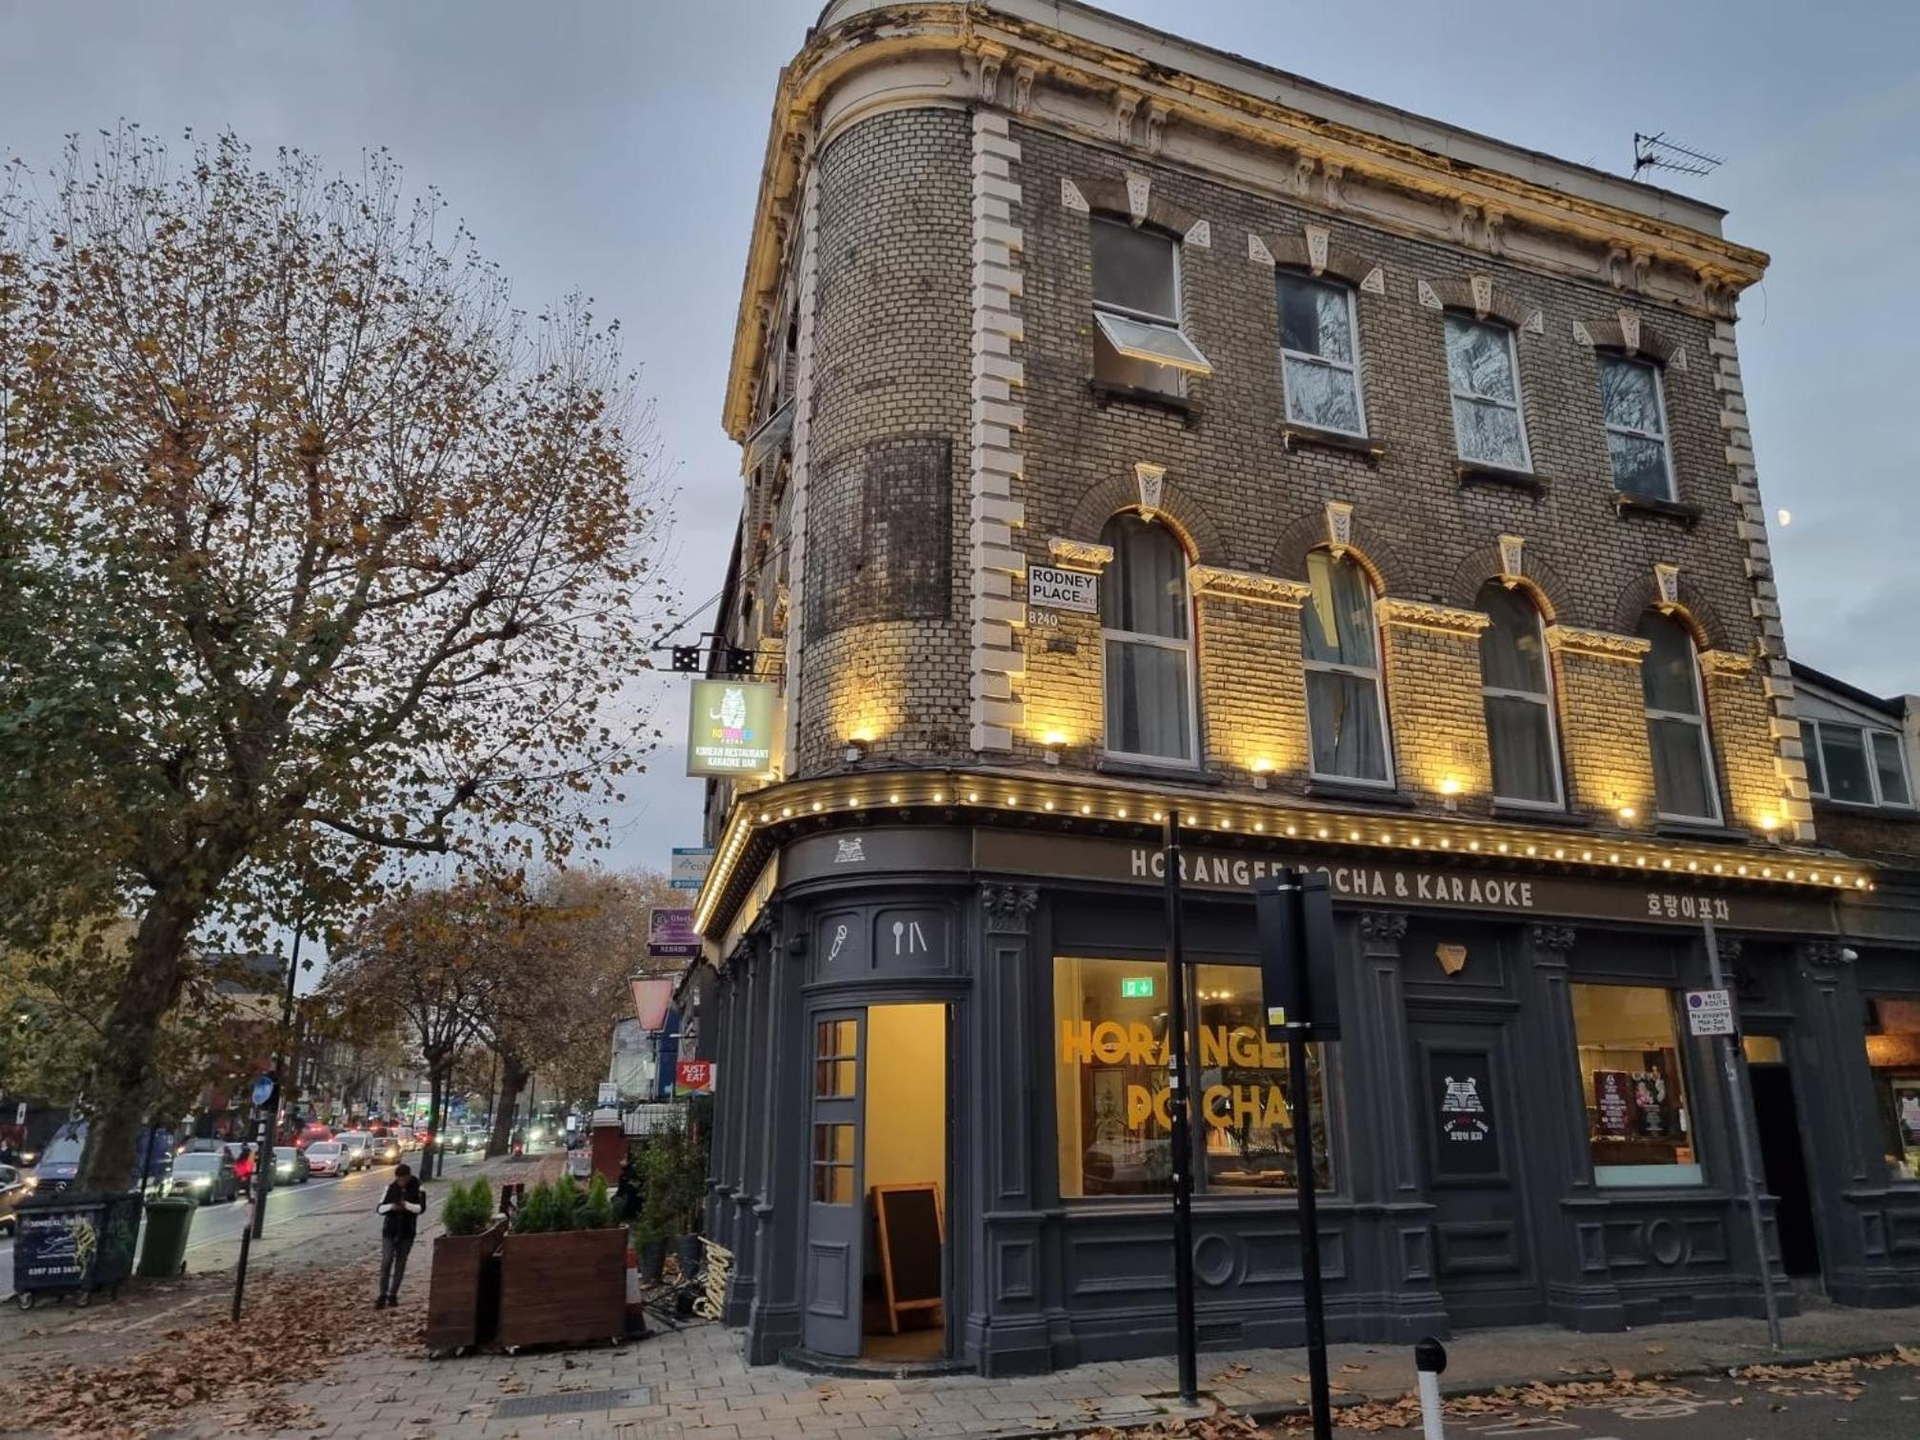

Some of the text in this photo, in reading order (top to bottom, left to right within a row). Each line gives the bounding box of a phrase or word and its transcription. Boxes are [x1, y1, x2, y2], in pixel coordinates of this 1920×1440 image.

[1033, 569, 1093, 589] RODNEY
[1033, 585, 1081, 602] PLACE
[1028, 611, 1058, 627] 8240
[695, 747, 769, 759] KOREAN RESTAURANT
[708, 757, 757, 768] KARAOKE BAR
[1394, 872, 1409, 897] &
[1416, 874, 1533, 907] KARAOKE
[1061, 1020, 1290, 1069] HORANGE
[682, 1064, 706, 1075] JUST
[686, 1073, 705, 1083] EAT
